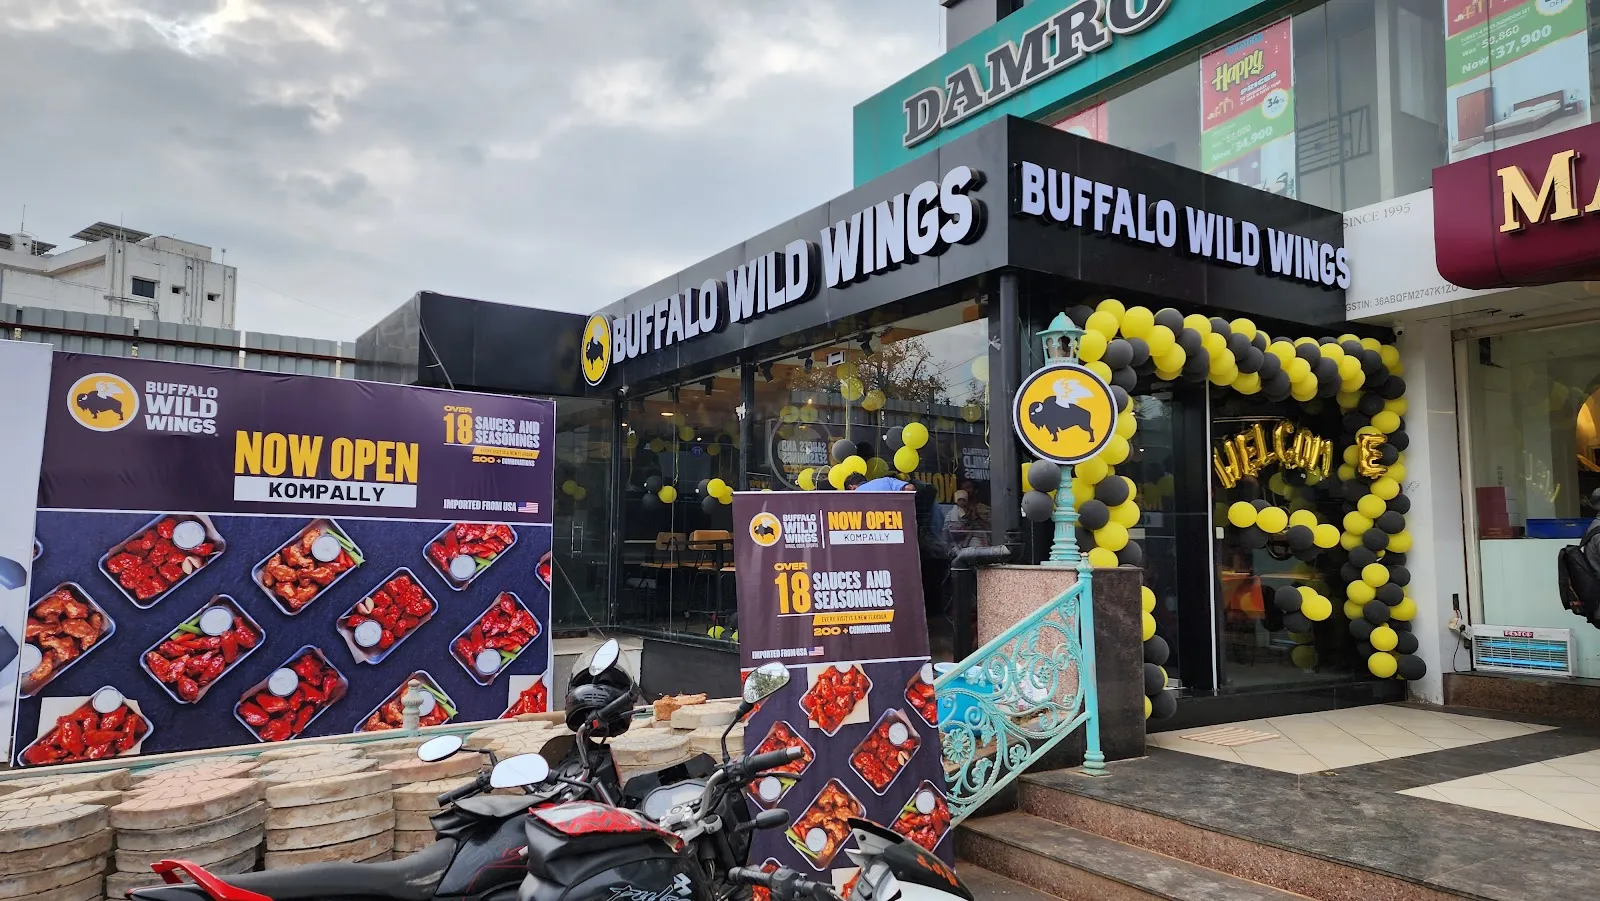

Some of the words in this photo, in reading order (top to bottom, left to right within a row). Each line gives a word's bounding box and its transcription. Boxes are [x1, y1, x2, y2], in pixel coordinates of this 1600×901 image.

[1211, 49, 1264, 92] Happy
[1462, 55, 1489, 74] Now
[1342, 211, 1379, 229] SINCE
[1384, 202, 1411, 219] 1995
[1021, 161, 1177, 248] BUFFALO
[1185, 205, 1260, 268] WILD
[1267, 228, 1351, 290] WINGS
[613, 287, 718, 362] BUFFALO
[726, 240, 810, 324] WILD
[821, 165, 976, 289] WINGS
[1345, 300, 1372, 312] GSTIN:
[145, 380, 218, 399] BUFFALO
[146, 393, 218, 418] WILD
[444, 405, 472, 413] OVER
[144, 413, 217, 435] WINGS
[444, 413, 472, 444] 18
[475, 416, 515, 433] SAUCES
[519, 420, 540, 435] AND
[475, 430, 540, 449] SEASONINGS
[234, 430, 323, 478] NOW
[331, 439, 419, 483] OPEN
[268, 481, 385, 502] KOMPALLY
[443, 499, 481, 511] IMPORTED
[482, 500, 502, 511] FROM
[502, 501, 517, 512] USA
[782, 514, 817, 522] BUFFALO
[783, 521, 818, 534] WILD
[828, 511, 862, 530] NOW
[866, 511, 903, 530] OPEN
[784, 533, 818, 544] WINGS
[844, 532, 890, 542] KOMPALLY
[774, 562, 808, 571] OVER
[812, 570, 861, 591] SAUCES
[866, 570, 891, 589] AND
[774, 571, 811, 614] 18
[814, 588, 894, 610] SEASONINGS
[813, 626, 841, 637] 200
[796, 647, 808, 657] USA
